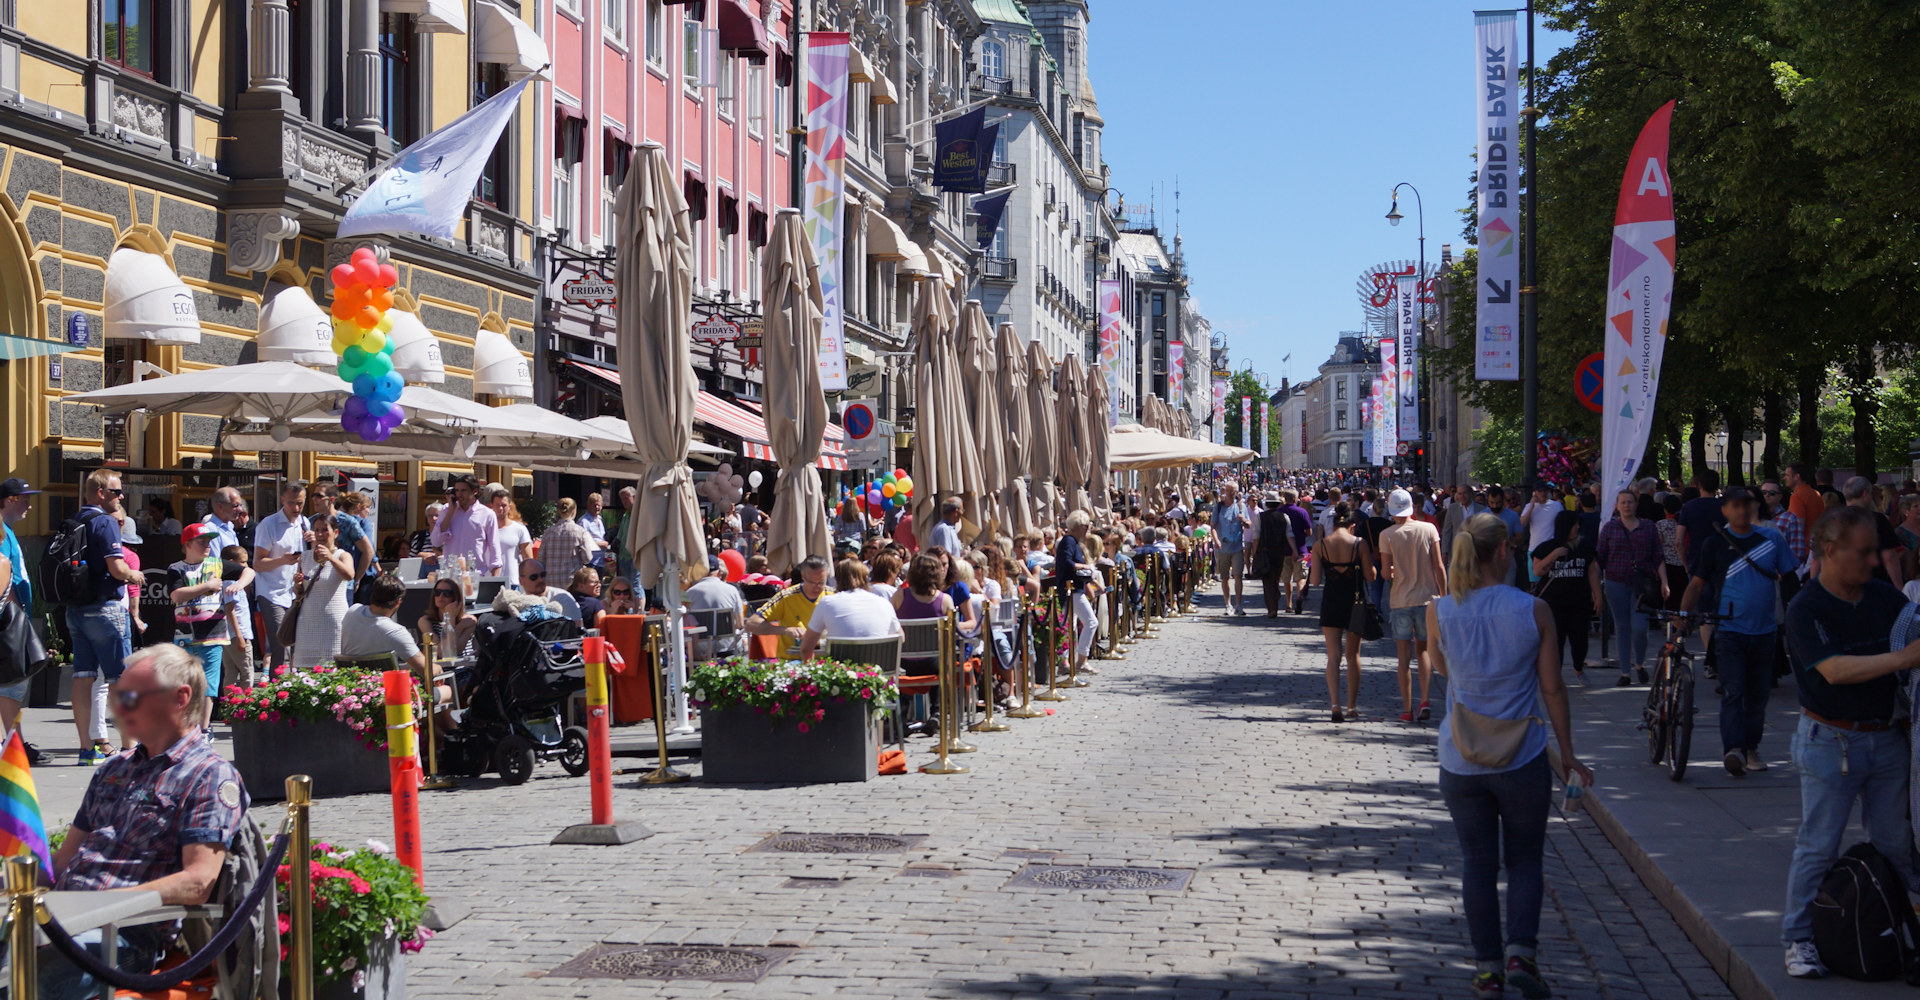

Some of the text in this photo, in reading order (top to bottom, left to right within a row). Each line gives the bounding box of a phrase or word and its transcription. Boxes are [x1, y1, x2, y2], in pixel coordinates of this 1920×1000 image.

[950, 151, 969, 160] Best
[942, 158, 976, 168] Western
[1637, 157, 1668, 197] A
[571, 286, 614, 295] FRIDAY'S
[698, 326, 735, 335] FRIDAY'S
[1642, 275, 1651, 393] gratiskondomer.no
[53, 365, 60, 376] 37
[1576, 558, 1586, 567] DO
